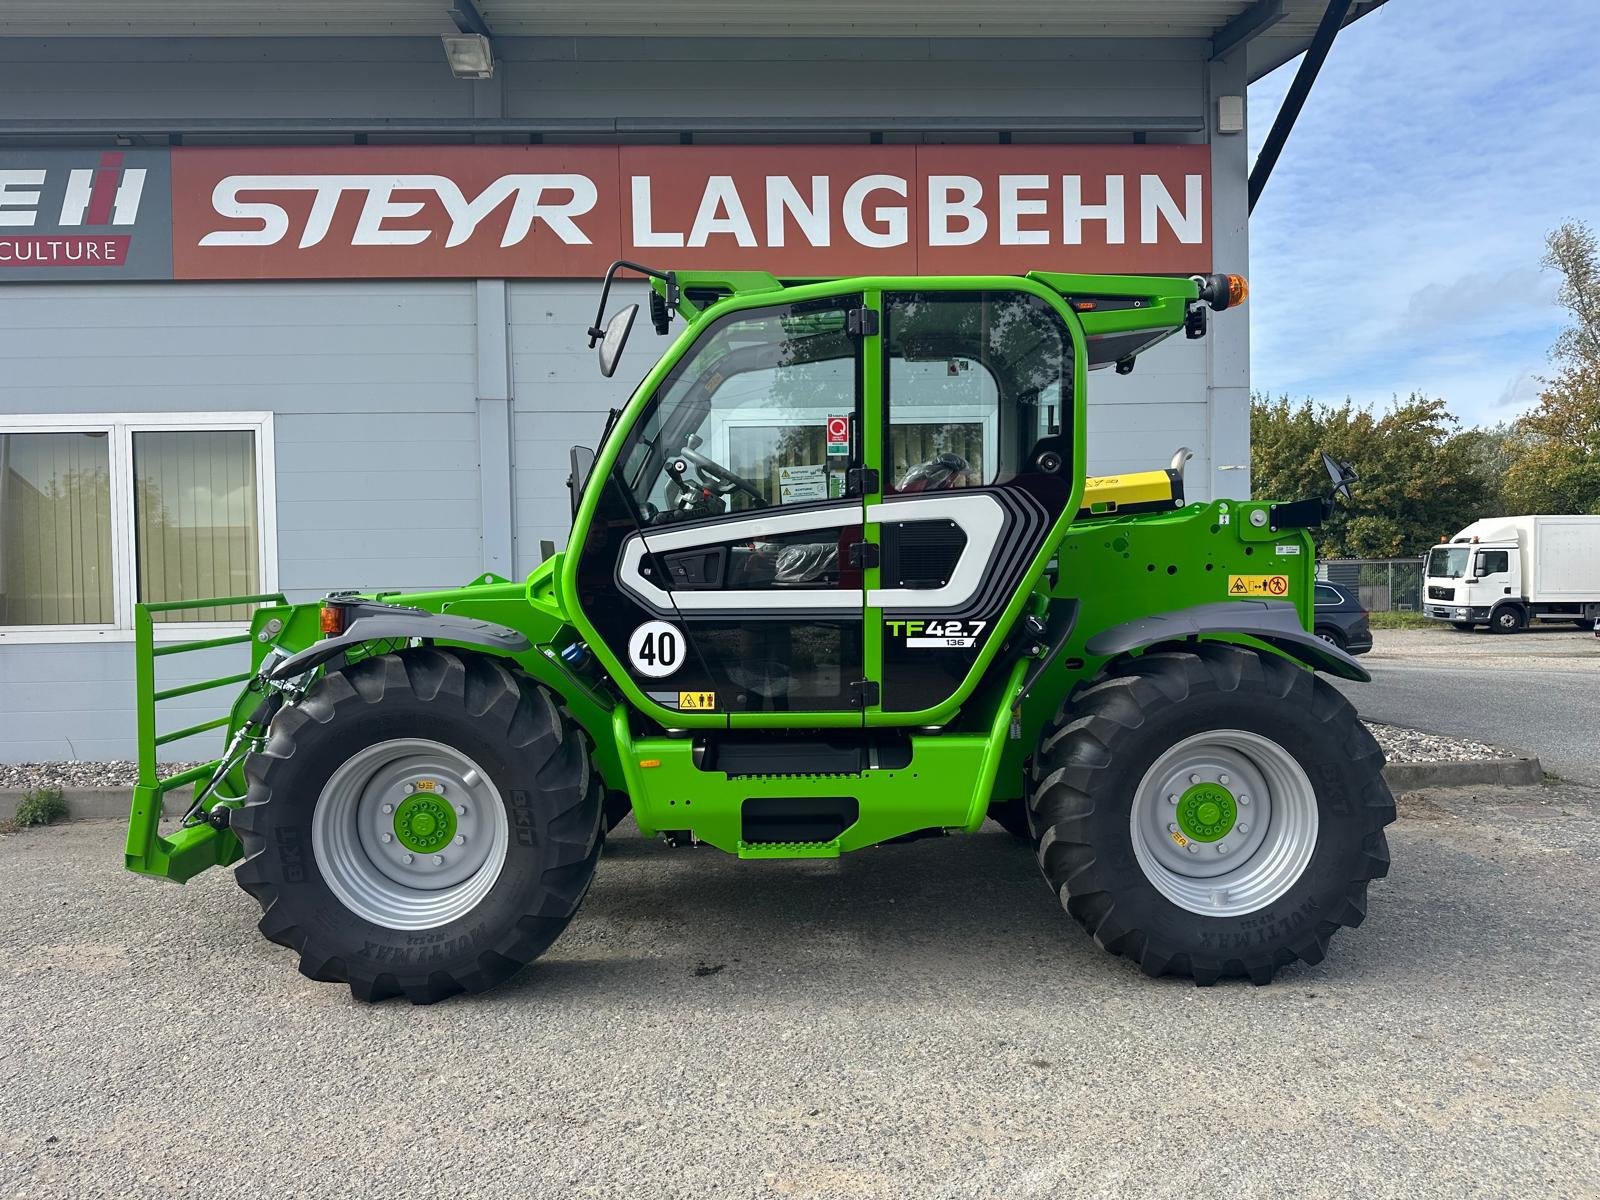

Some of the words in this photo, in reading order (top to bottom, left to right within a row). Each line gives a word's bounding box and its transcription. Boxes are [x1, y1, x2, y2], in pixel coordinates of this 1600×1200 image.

[197, 173, 598, 248] STEYR
[631, 174, 1202, 248] LANGBEHN
[829, 419, 846, 436] Q
[639, 631, 676, 666] 40
[886, 621, 987, 637] TF42.7
[511, 789, 538, 848] BKT
[275, 825, 305, 883] BKT
